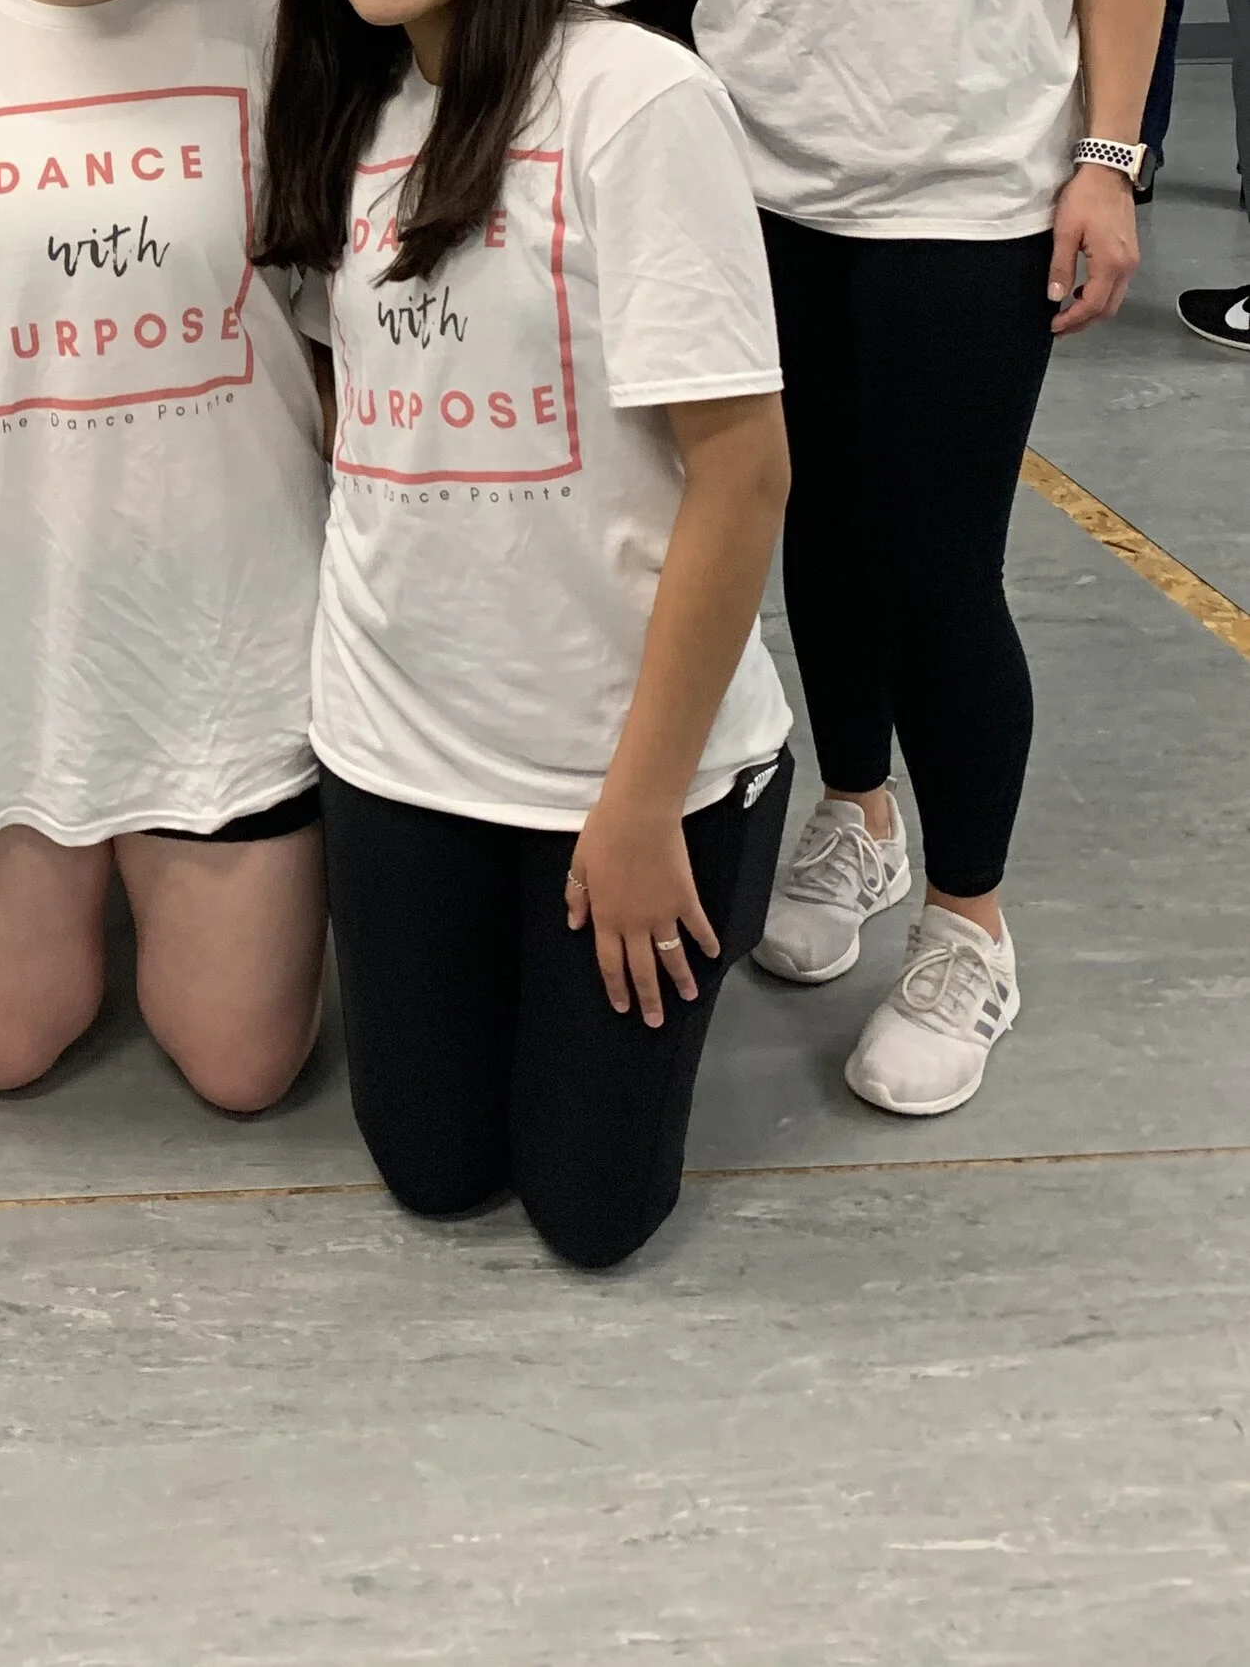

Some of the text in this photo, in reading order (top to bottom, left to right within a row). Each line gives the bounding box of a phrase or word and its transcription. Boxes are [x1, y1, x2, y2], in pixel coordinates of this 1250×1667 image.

[48, 215, 170, 277] with
[352, 209, 507, 254] DAE
[378, 286, 468, 349] with
[51, 412, 134, 431] Dance
[158, 392, 234, 420] Pointe
[350, 385, 557, 430] URPOSE
[470, 485, 571, 503] Pointe
